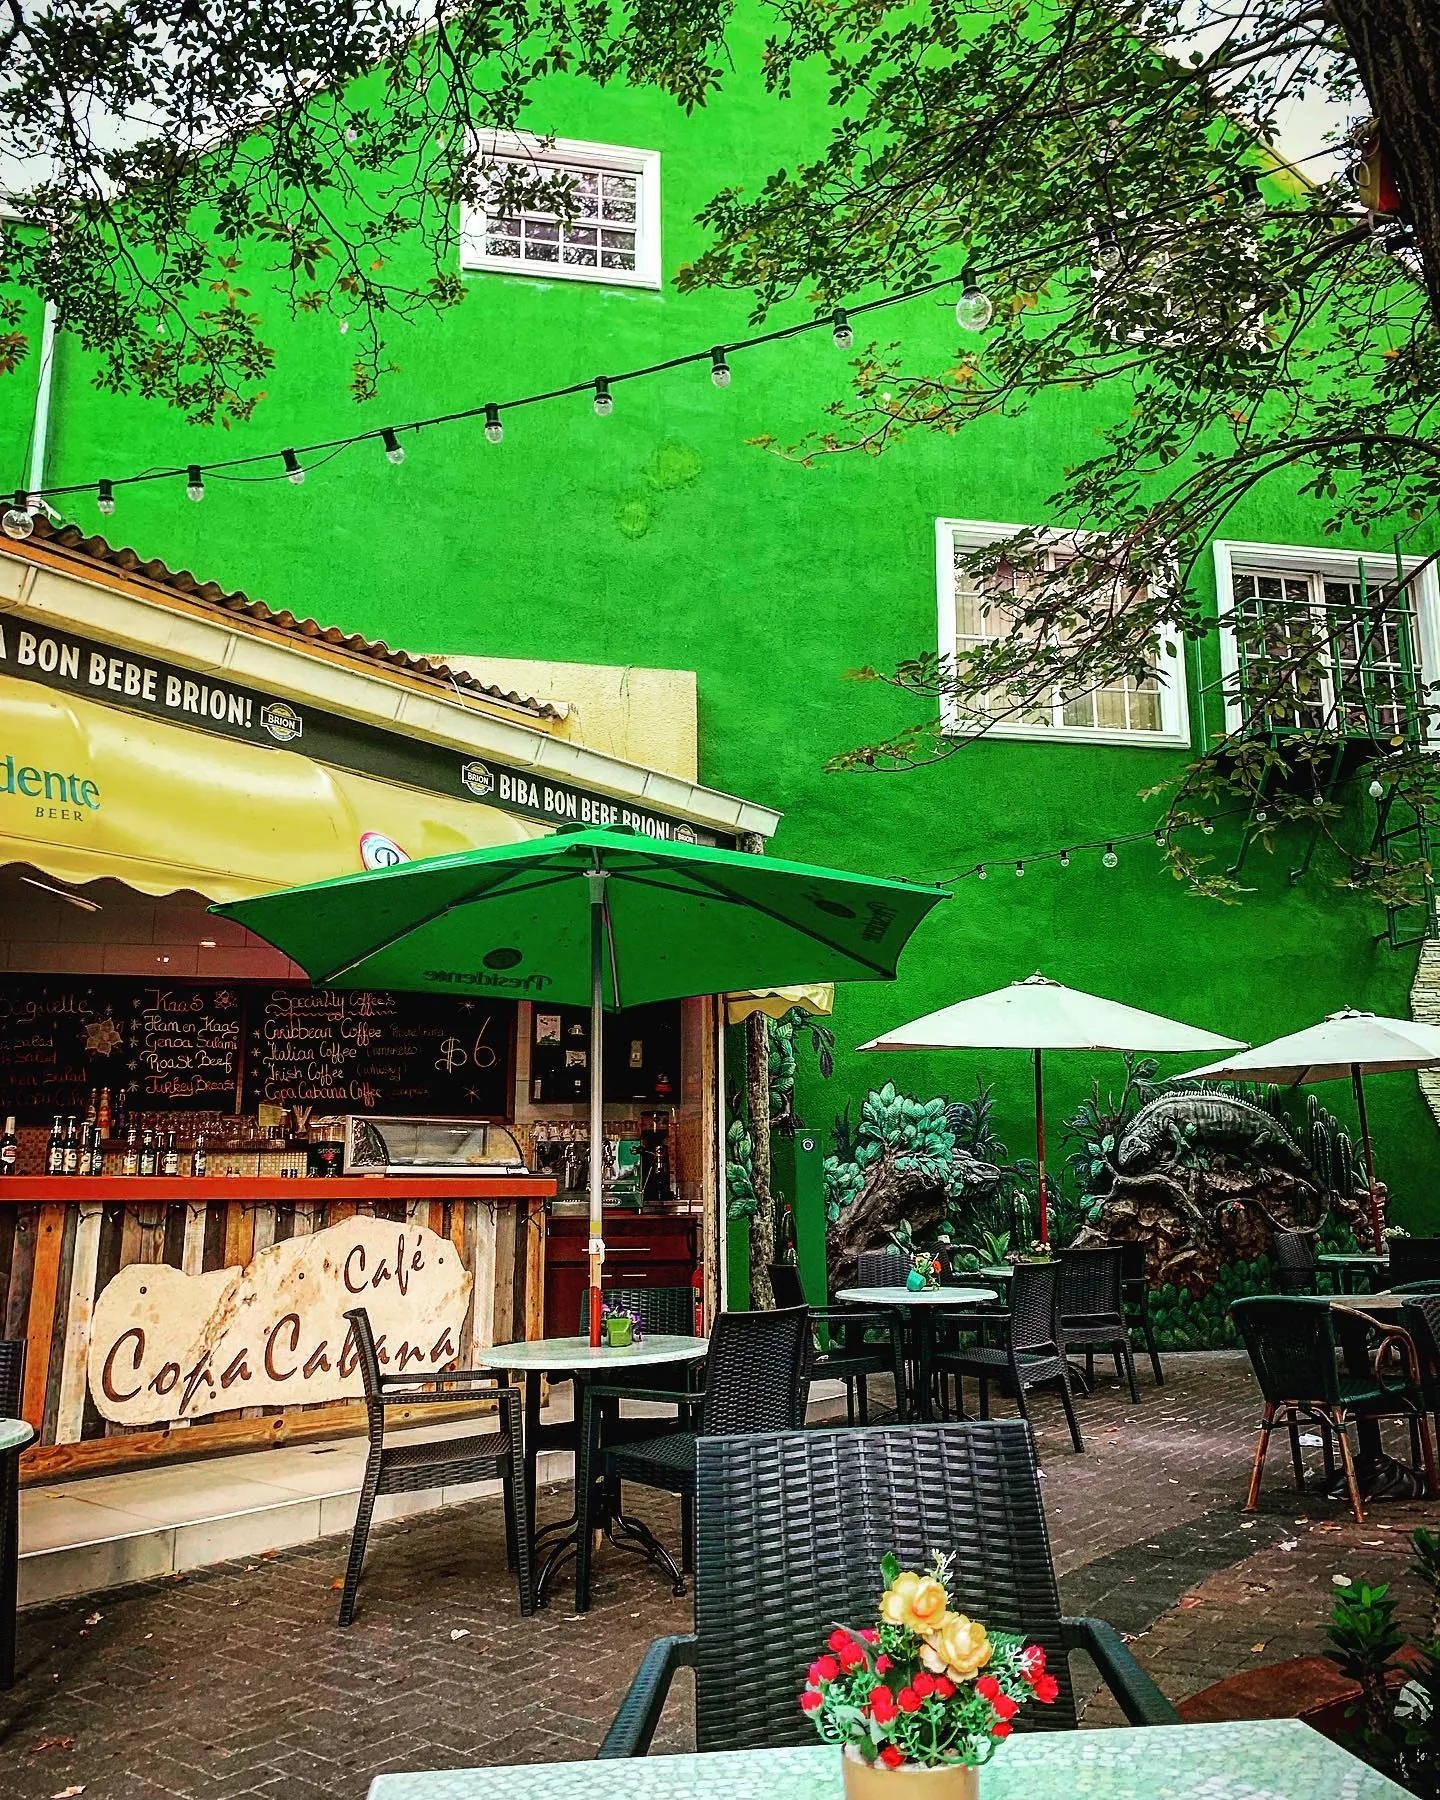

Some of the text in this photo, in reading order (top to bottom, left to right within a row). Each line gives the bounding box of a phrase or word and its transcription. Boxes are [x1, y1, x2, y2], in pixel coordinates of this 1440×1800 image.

[17, 631, 80, 680] BON
[88, 652, 158, 702] BEBE
[165, 675, 253, 729] BRION!
[267, 713, 296, 730] BRION
[467, 771, 489, 786] BRION
[499, 773, 541, 809] BIBA
[544, 786, 577, 820] BON
[581, 797, 618, 825] BEBE
[35, 806, 84, 822] BEER
[143, 1015, 240, 1039] Ham en Kaas
[340, 1017, 383, 1046] Coffee
[145, 1033, 238, 1052] Genoa Salami
[262, 1041, 315, 1064] Italian
[319, 1040, 358, 1064] Coffee
[140, 1049, 233, 1074] Roast Beef
[265, 1063, 303, 1083] Irish
[307, 1062, 344, 1085] Coffee
[145, 1072, 236, 1098] Turkey Breast
[298, 1080, 348, 1100] Cabana
[350, 1079, 383, 1107] Coffee
[343, 1233, 426, 1296] Café
